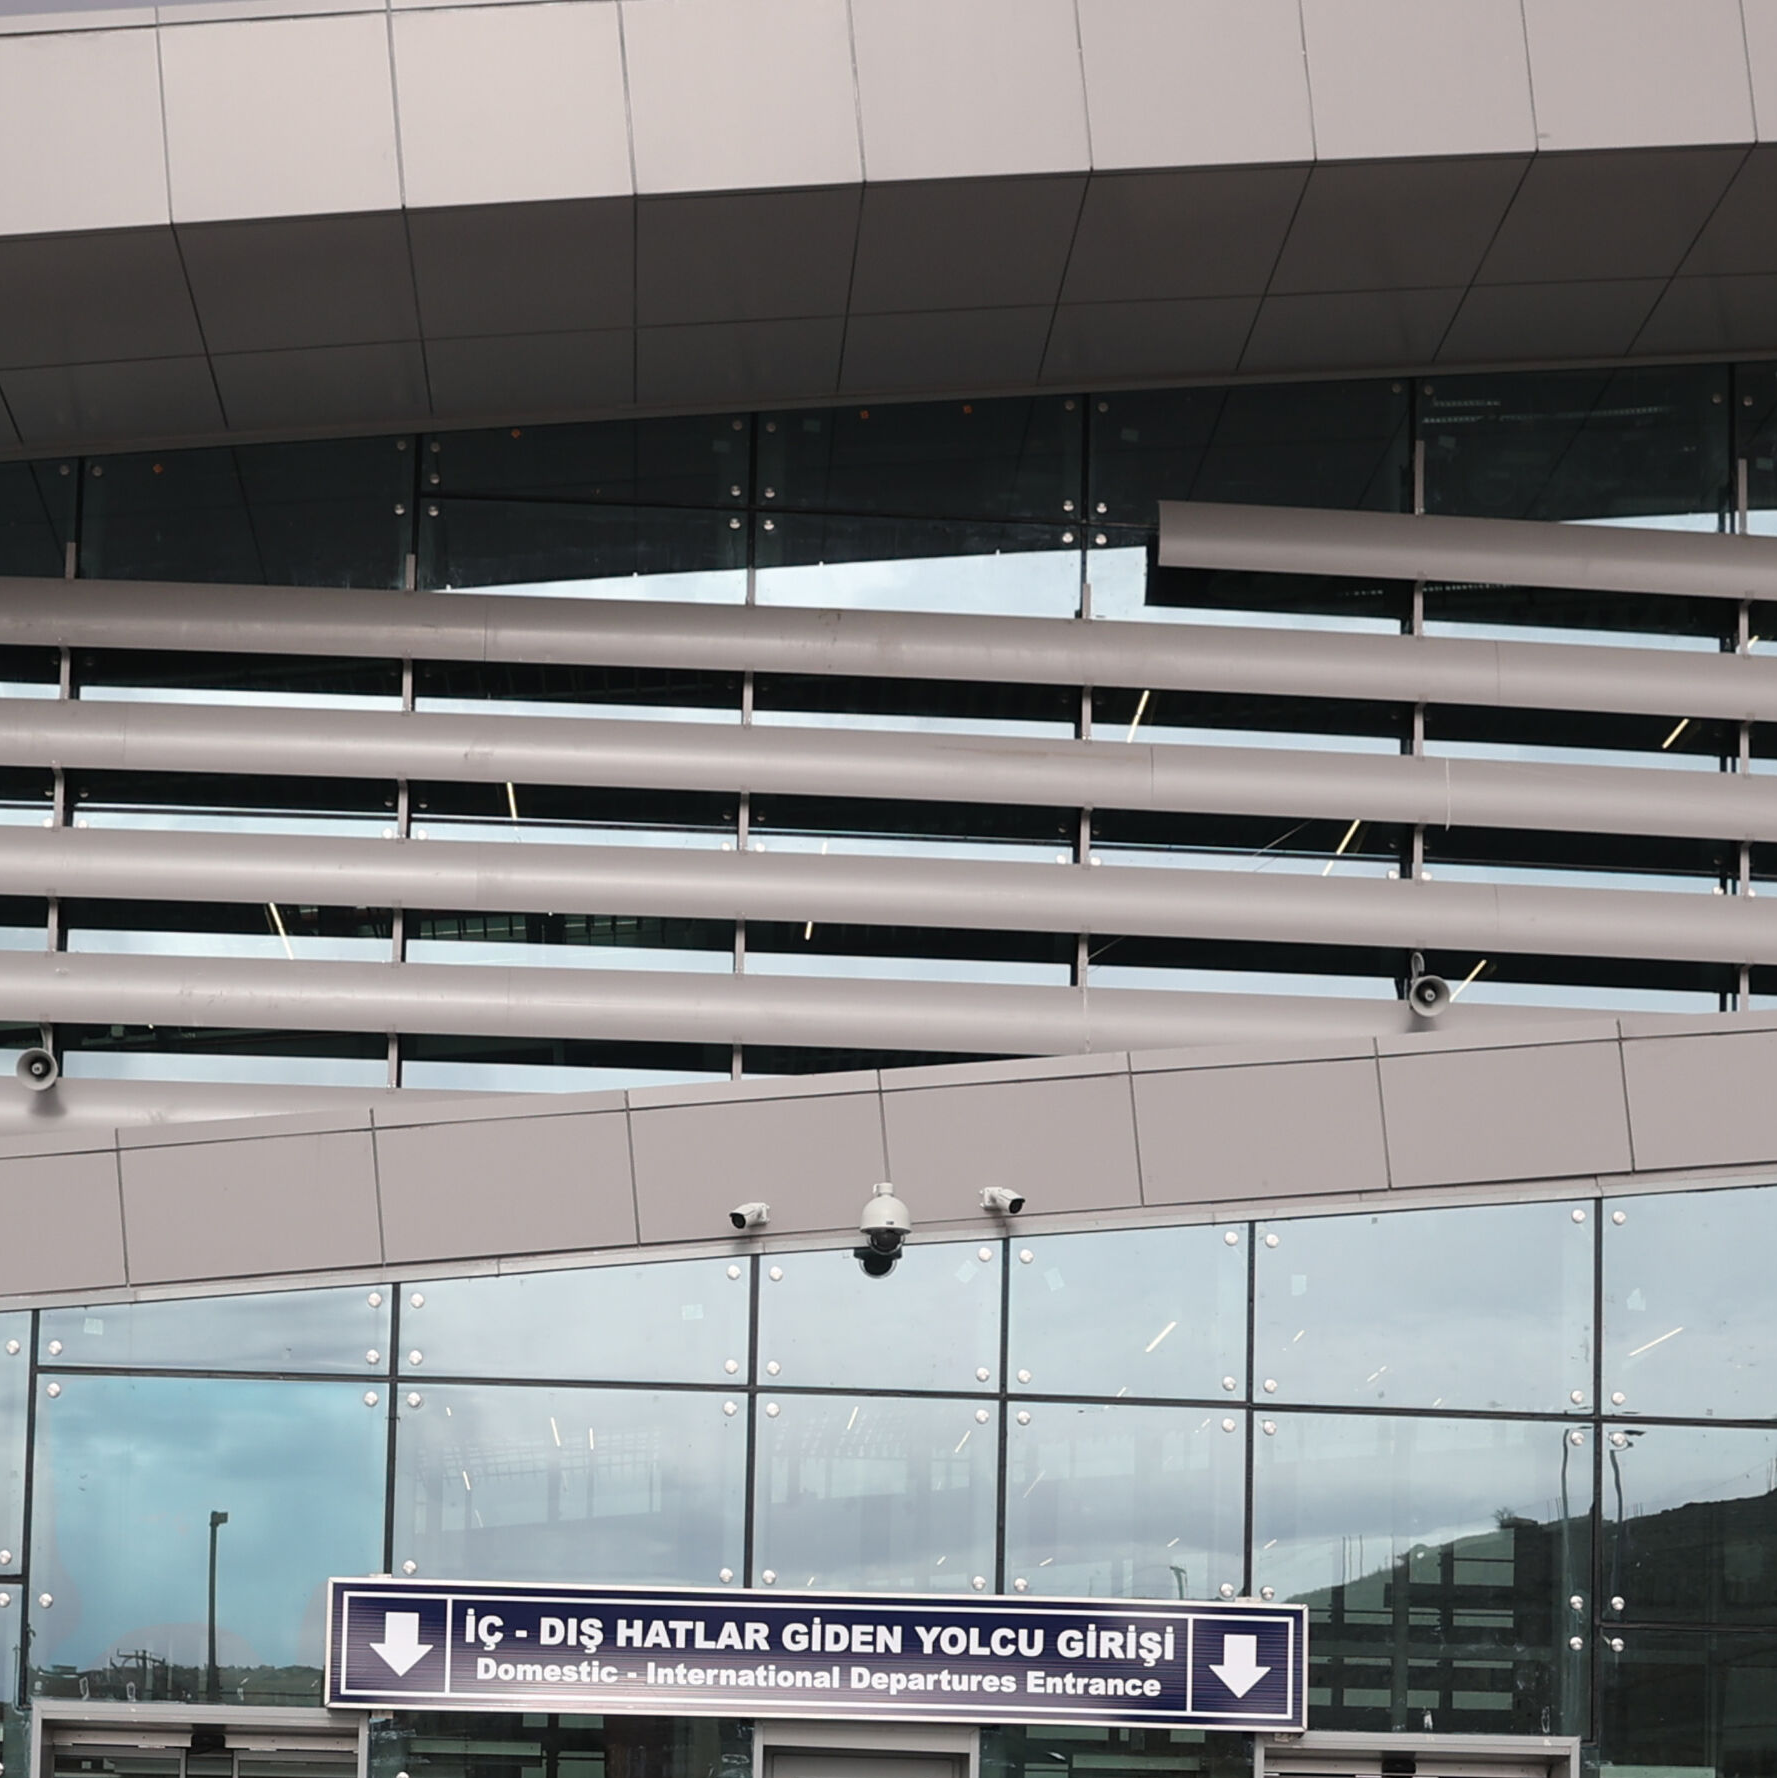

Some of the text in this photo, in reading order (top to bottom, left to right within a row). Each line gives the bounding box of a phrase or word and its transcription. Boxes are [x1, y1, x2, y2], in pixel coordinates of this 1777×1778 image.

[465, 1608, 1174, 1667] İÇ - DIŞ HATLAR GİDEN YOLCU GİRİŞİ
[476, 1657, 618, 1683] Domestic
[647, 1662, 840, 1689] International
[850, 1667, 1017, 1695] Departures
[1026, 1671, 1161, 1697] Entrance
